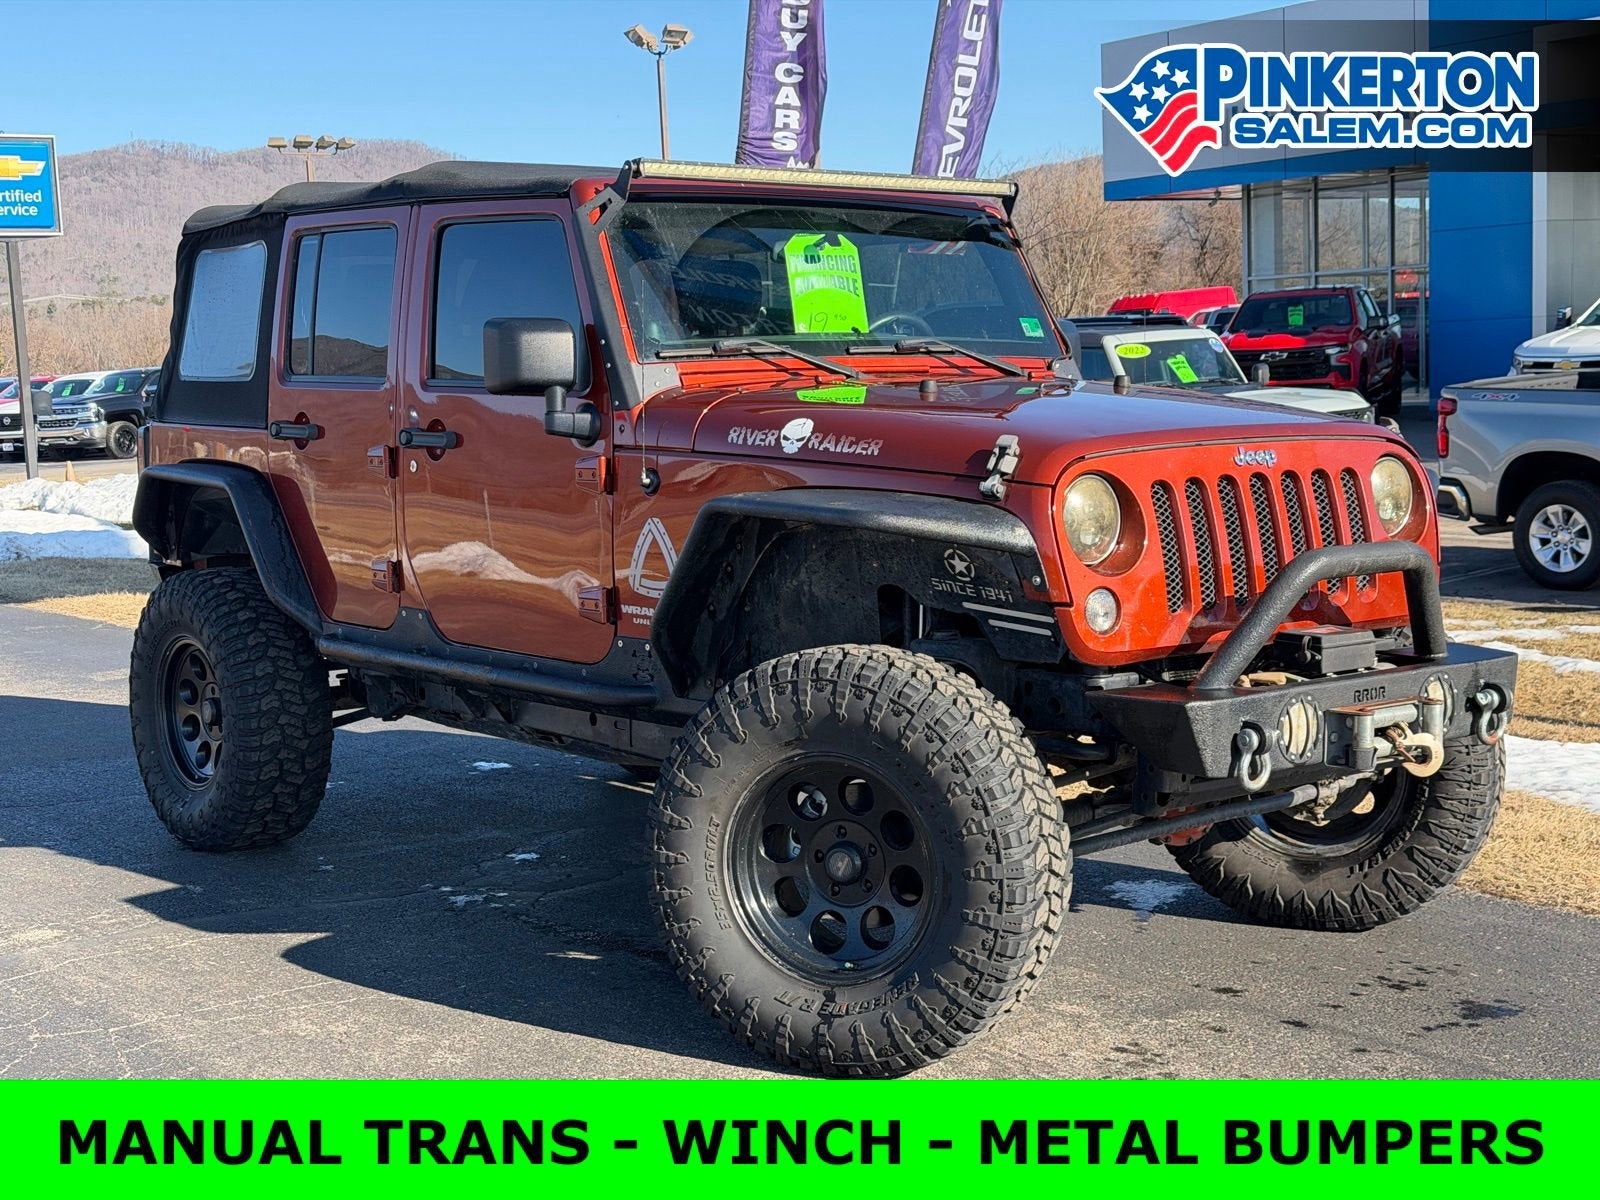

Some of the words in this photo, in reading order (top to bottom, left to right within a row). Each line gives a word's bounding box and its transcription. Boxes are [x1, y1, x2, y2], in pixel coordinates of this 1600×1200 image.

[780, 0, 810, 51] UY
[771, 62, 804, 151] CARS
[728, 426, 779, 447] RIVER
[808, 432, 883, 456] RAIDER
[1232, 446, 1277, 469] Jeep
